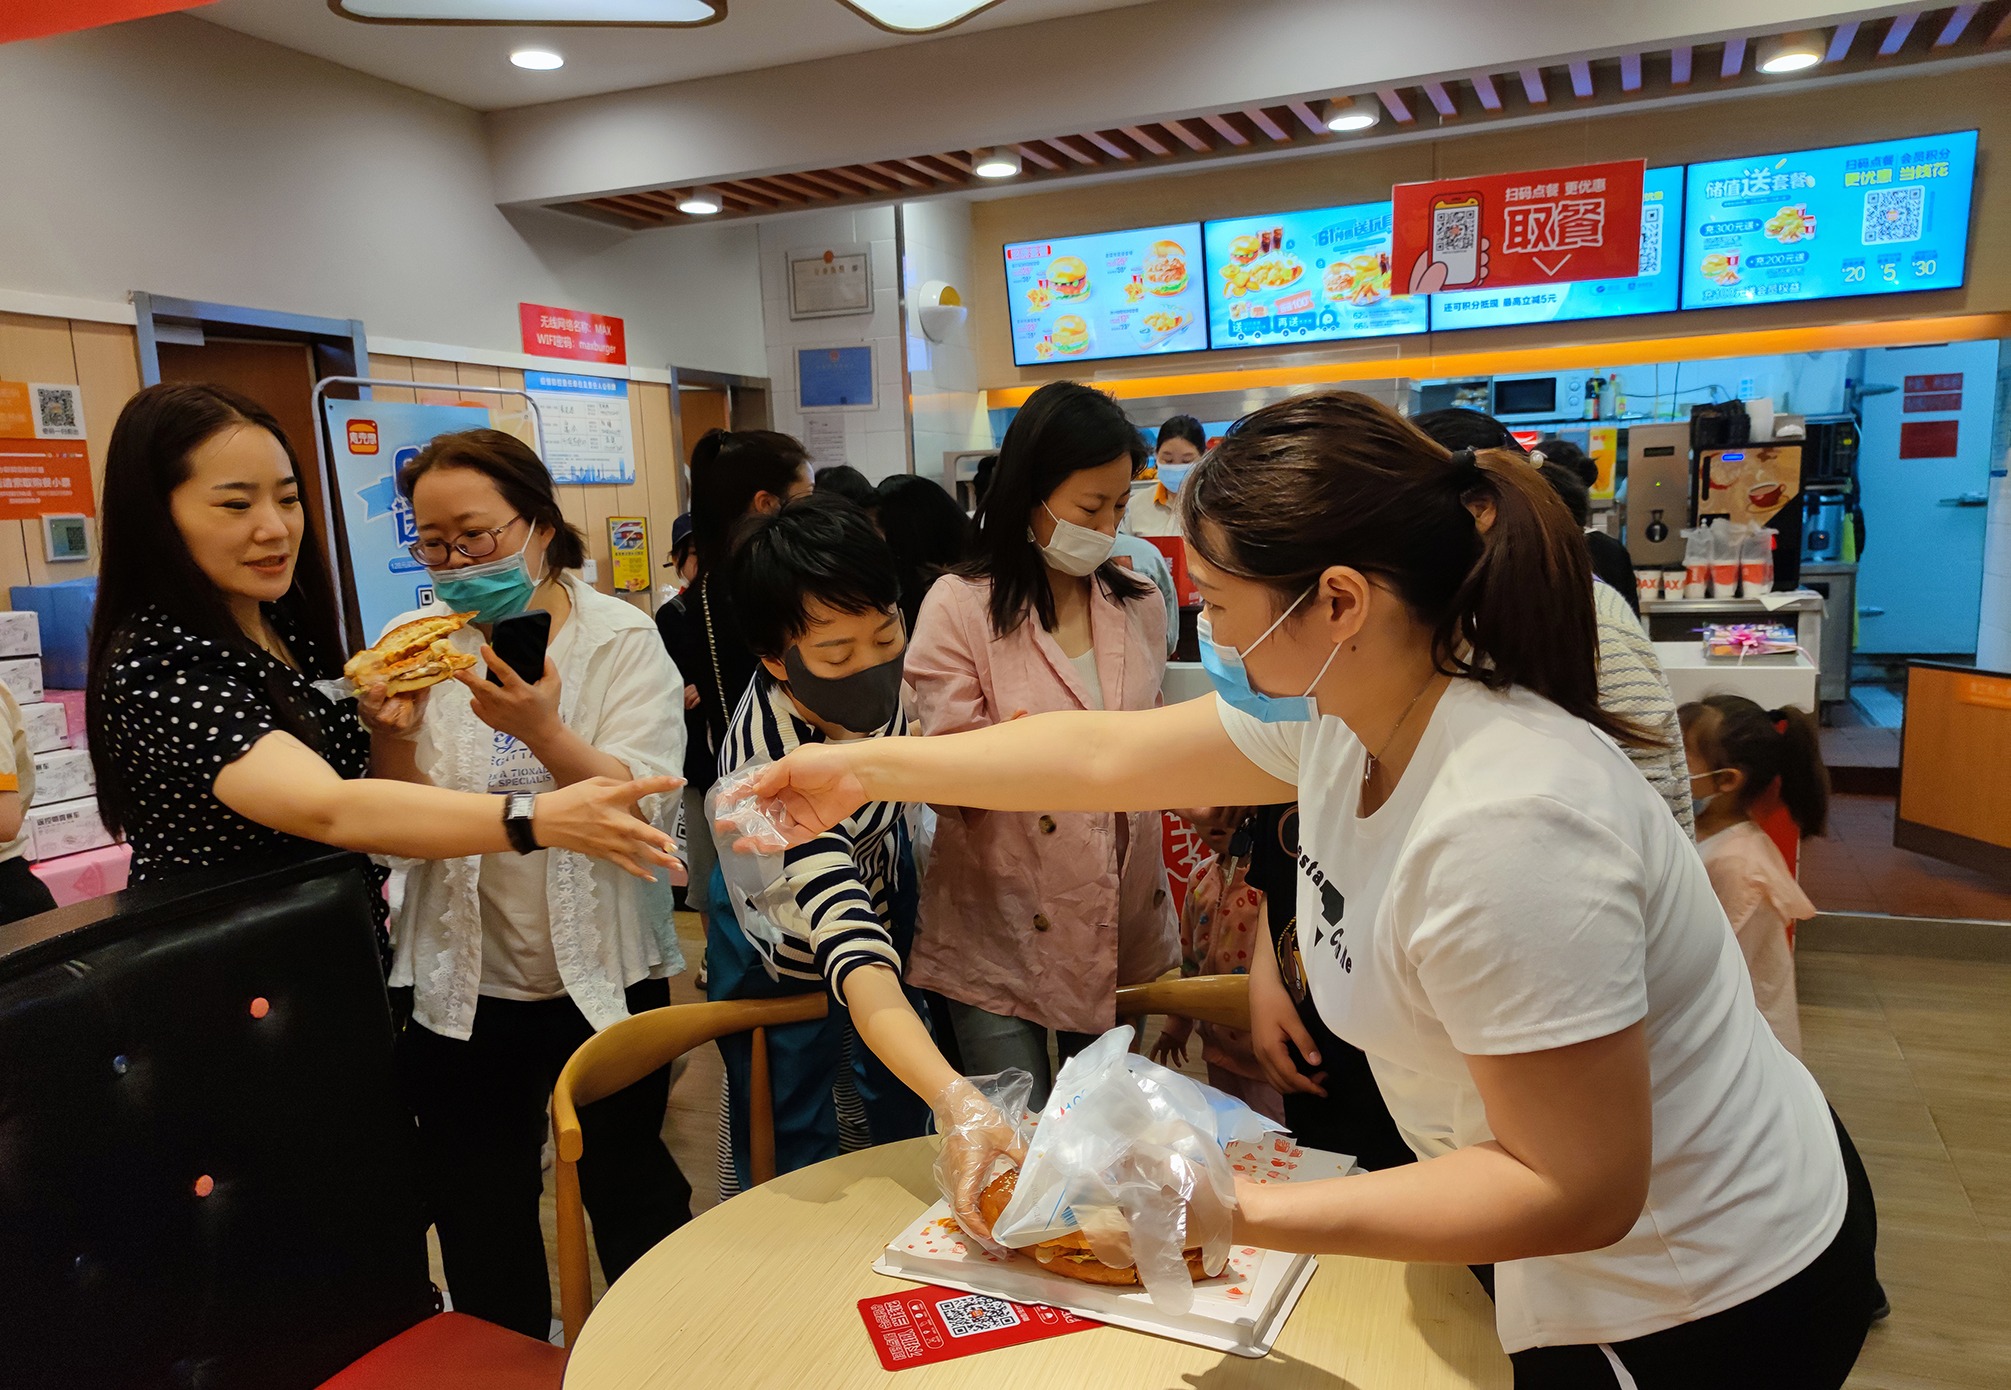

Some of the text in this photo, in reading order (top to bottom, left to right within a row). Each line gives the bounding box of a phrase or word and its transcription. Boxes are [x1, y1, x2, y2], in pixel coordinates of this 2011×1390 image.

[1505, 178, 1606, 202] 扫码点餐 更优惠
[1705, 167, 1808, 198] 储值送套餐
[1503, 198, 1605, 254] 取餐
[1444, 293, 1557, 313] 还可积分抵现 最高立减5元
